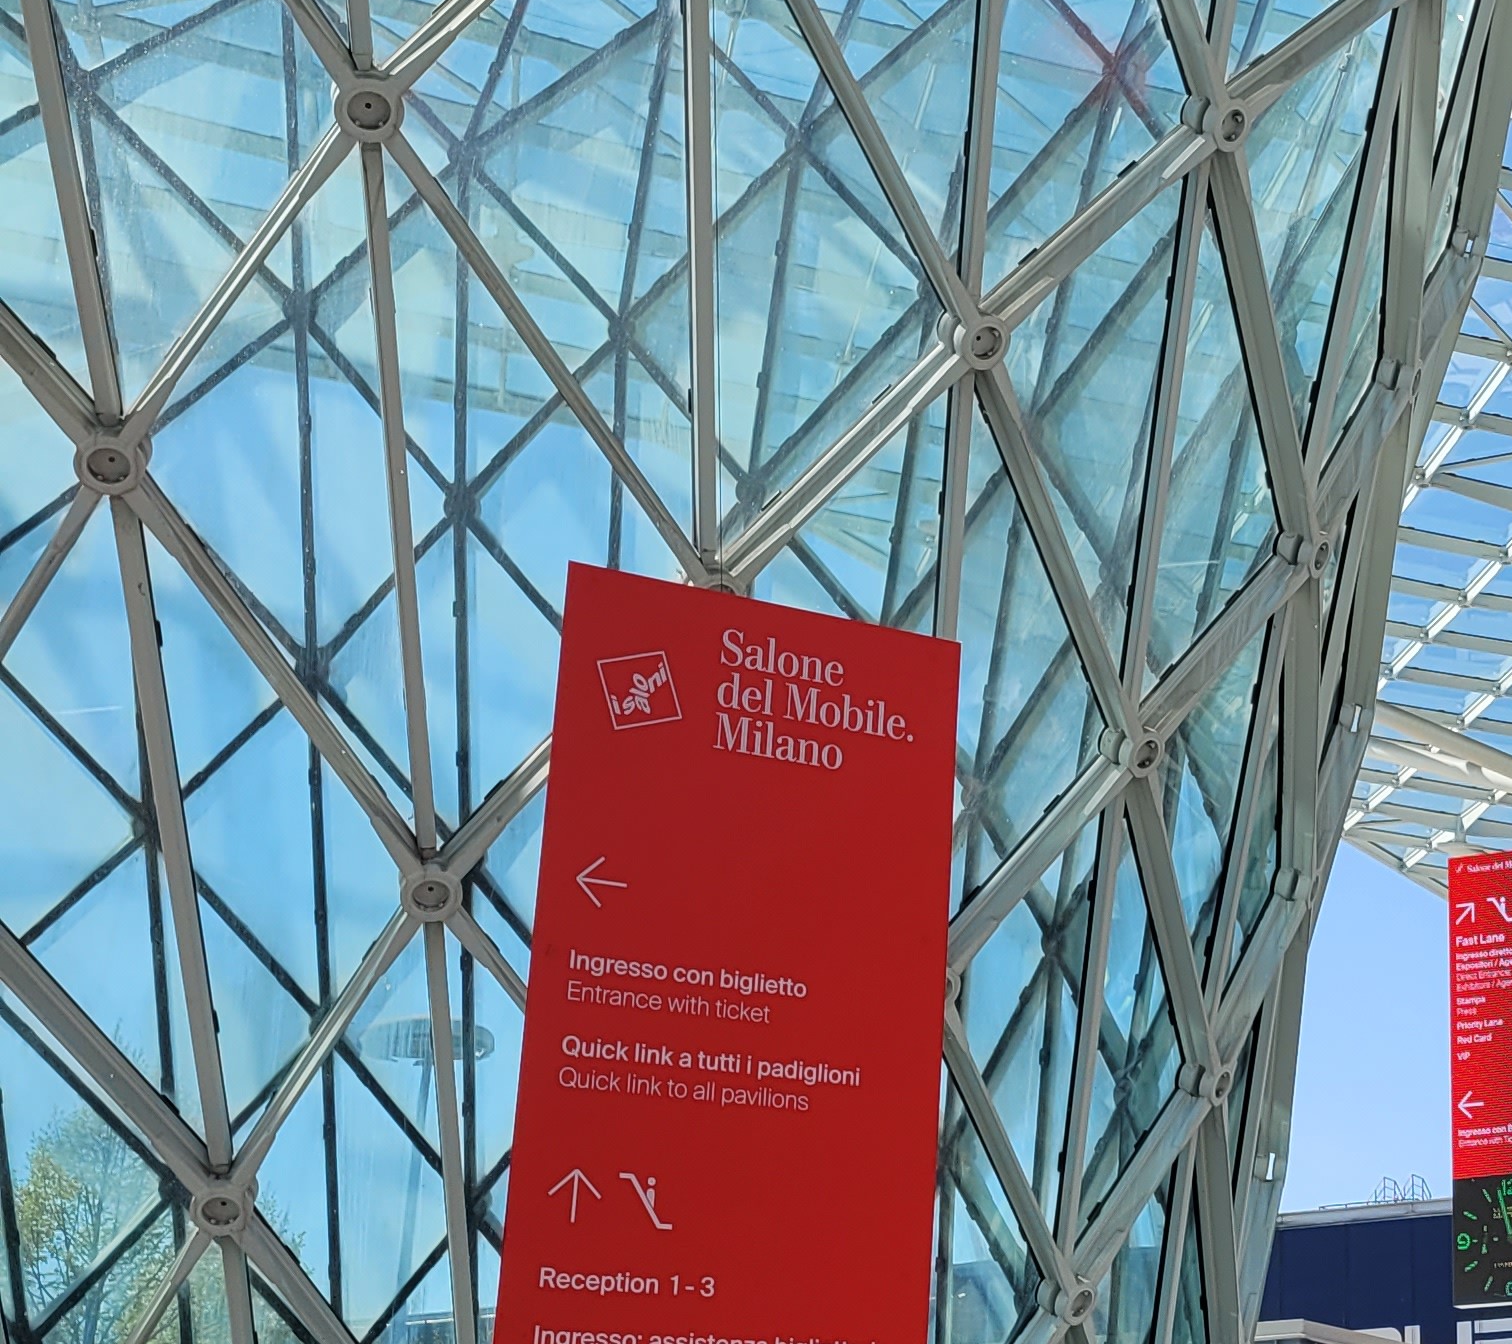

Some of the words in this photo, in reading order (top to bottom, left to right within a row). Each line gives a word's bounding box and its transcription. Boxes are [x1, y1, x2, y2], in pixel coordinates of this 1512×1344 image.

[720, 629, 845, 687] Salone
[717, 671, 773, 716] del
[783, 682, 914, 742] Mobile.
[713, 712, 843, 771] Milano
[1456, 936, 1478, 947] Fast
[1480, 934, 1505, 944] Lane
[569, 949, 668, 980] Ingresso
[672, 967, 714, 987] con
[719, 968, 807, 998] biglietto
[567, 979, 663, 1011] Entrance
[667, 994, 710, 1017] with
[715, 999, 771, 1024] ticket
[1457, 1020, 1483, 1030] Priority
[1484, 1018, 1503, 1027] Lane
[561, 1035, 629, 1062] Quick
[634, 1042, 674, 1067] link
[678, 1052, 692, 1069] a
[697, 1050, 741, 1073] tutti
[746, 1055, 752, 1075] i
[757, 1060, 861, 1087] padiglioni
[1457, 1036, 1472, 1044] Red
[1474, 1033, 1492, 1042] Card
[1457, 1052, 1471, 1061] VIP
[559, 1066, 621, 1092] Quick
[626, 1072, 662, 1097] link
[666, 1079, 688, 1099] to
[692, 1081, 716, 1102] all
[721, 1086, 809, 1111] pavilions
[539, 1266, 659, 1296] Reception
